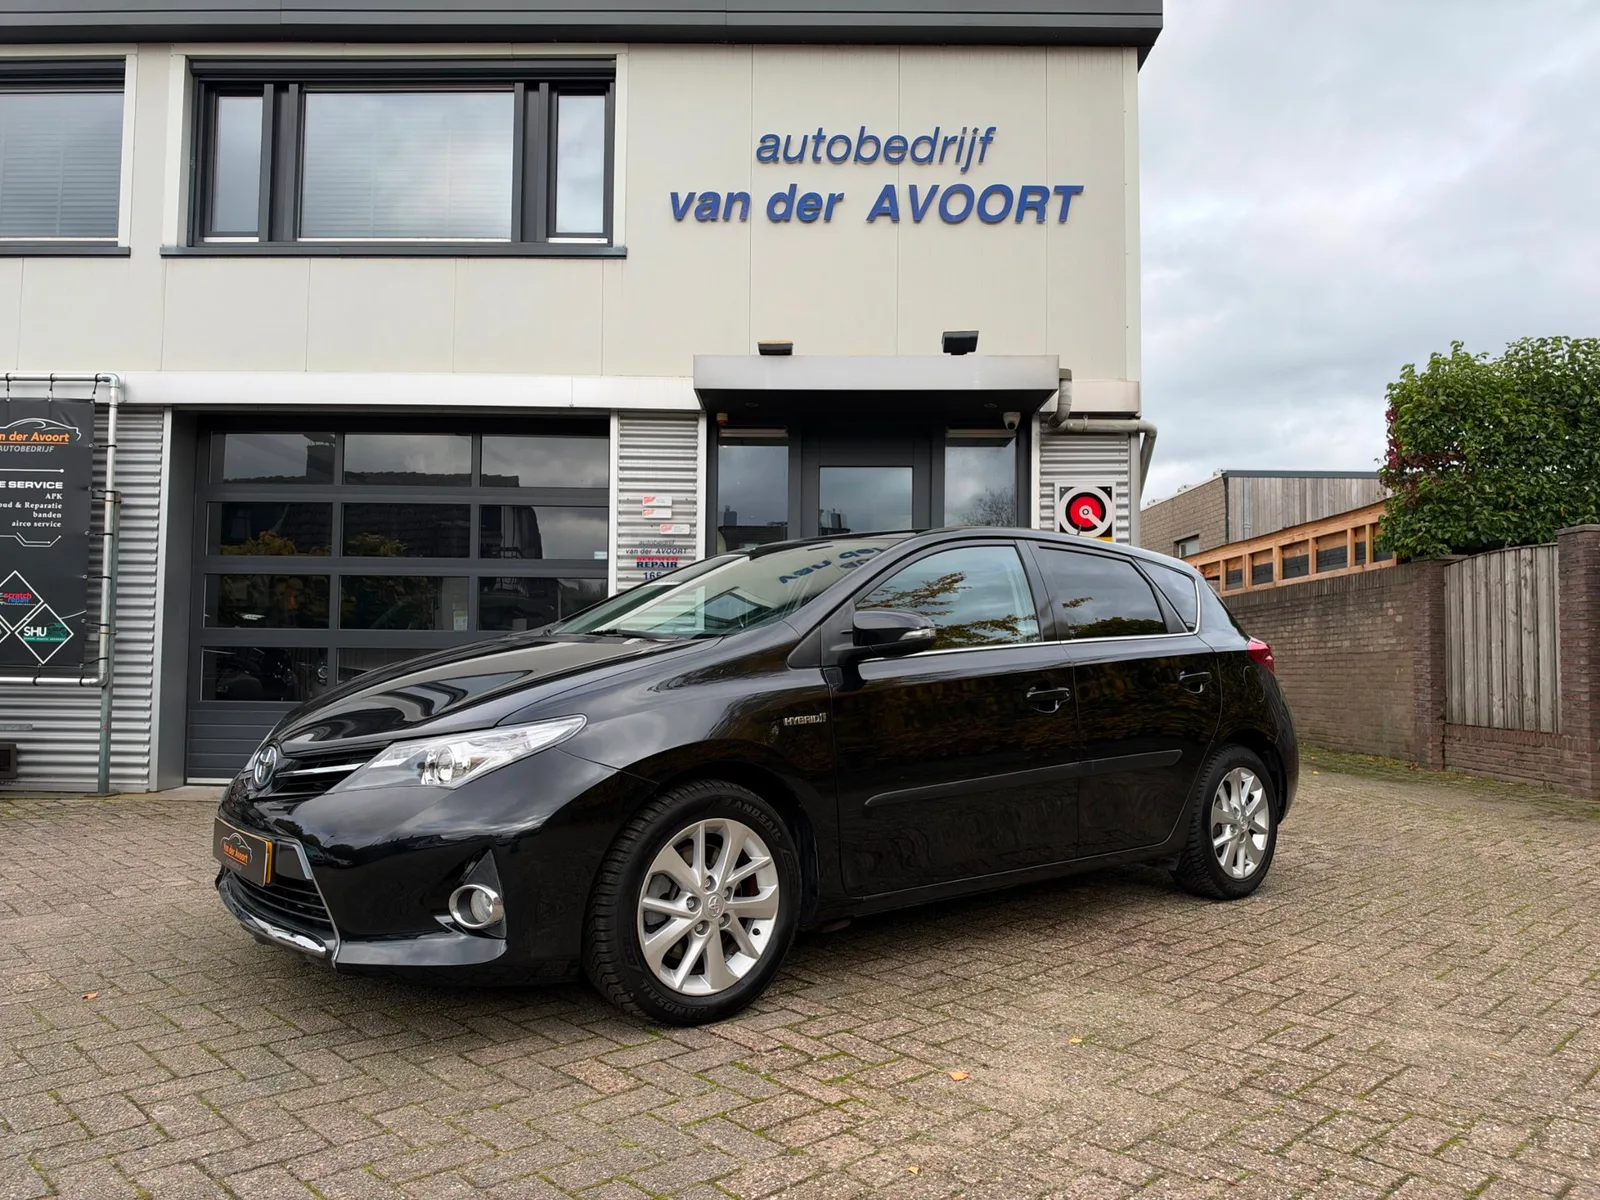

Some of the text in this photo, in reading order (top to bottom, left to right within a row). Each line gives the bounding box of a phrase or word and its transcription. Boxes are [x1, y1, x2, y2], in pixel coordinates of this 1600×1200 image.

[756, 126, 996, 173] autobedrijf
[670, 184, 1084, 224] van der AVOORT
[9, 431, 28, 441] der
[30, 432, 70, 442] Avoort
[8, 481, 64, 489] SERVICE
[24, 502, 62, 510] Reparatie
[23, 626, 47, 637] SHU
[784, 714, 821, 726] HYBRID
